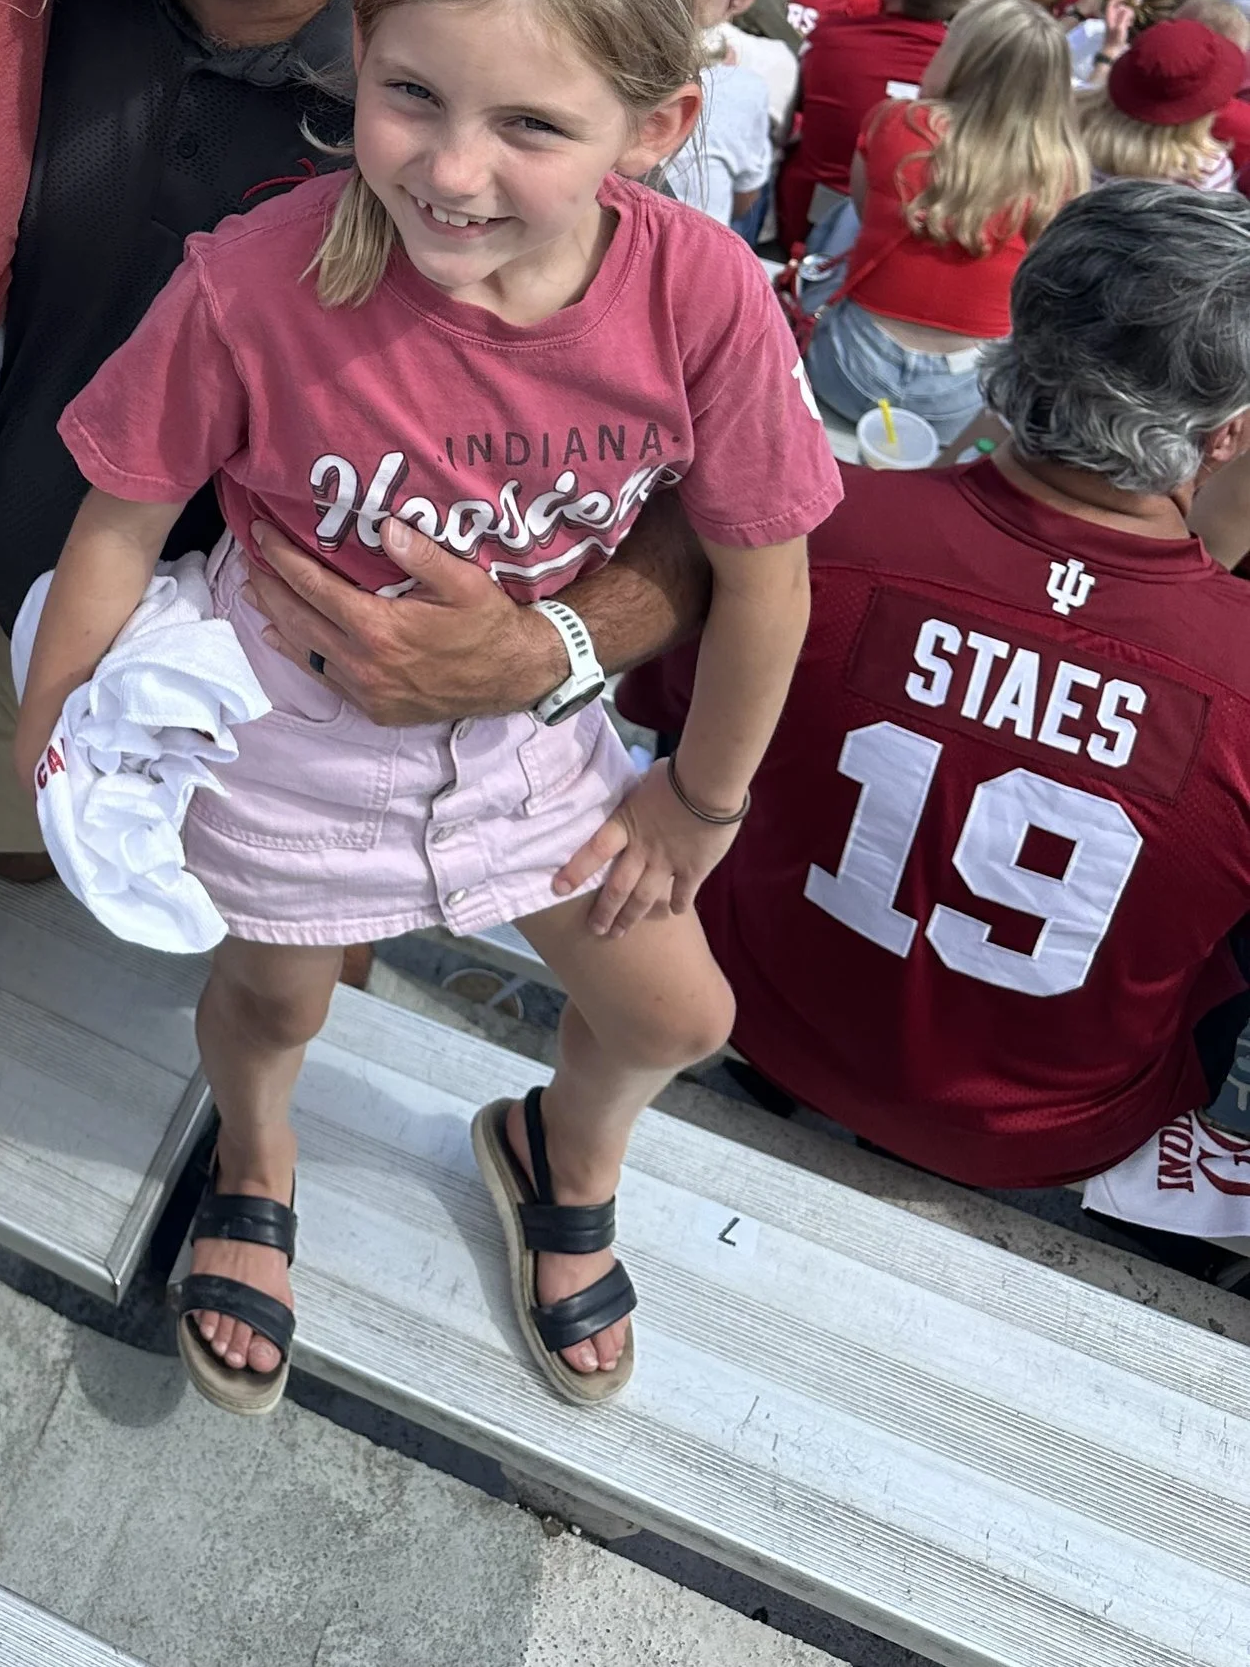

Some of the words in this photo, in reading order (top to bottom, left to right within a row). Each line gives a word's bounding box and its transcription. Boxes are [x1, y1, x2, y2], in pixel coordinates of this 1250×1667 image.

[445, 421, 664, 473] INDIANA
[904, 618, 1148, 769] STAES
[803, 720, 1144, 998] 19
